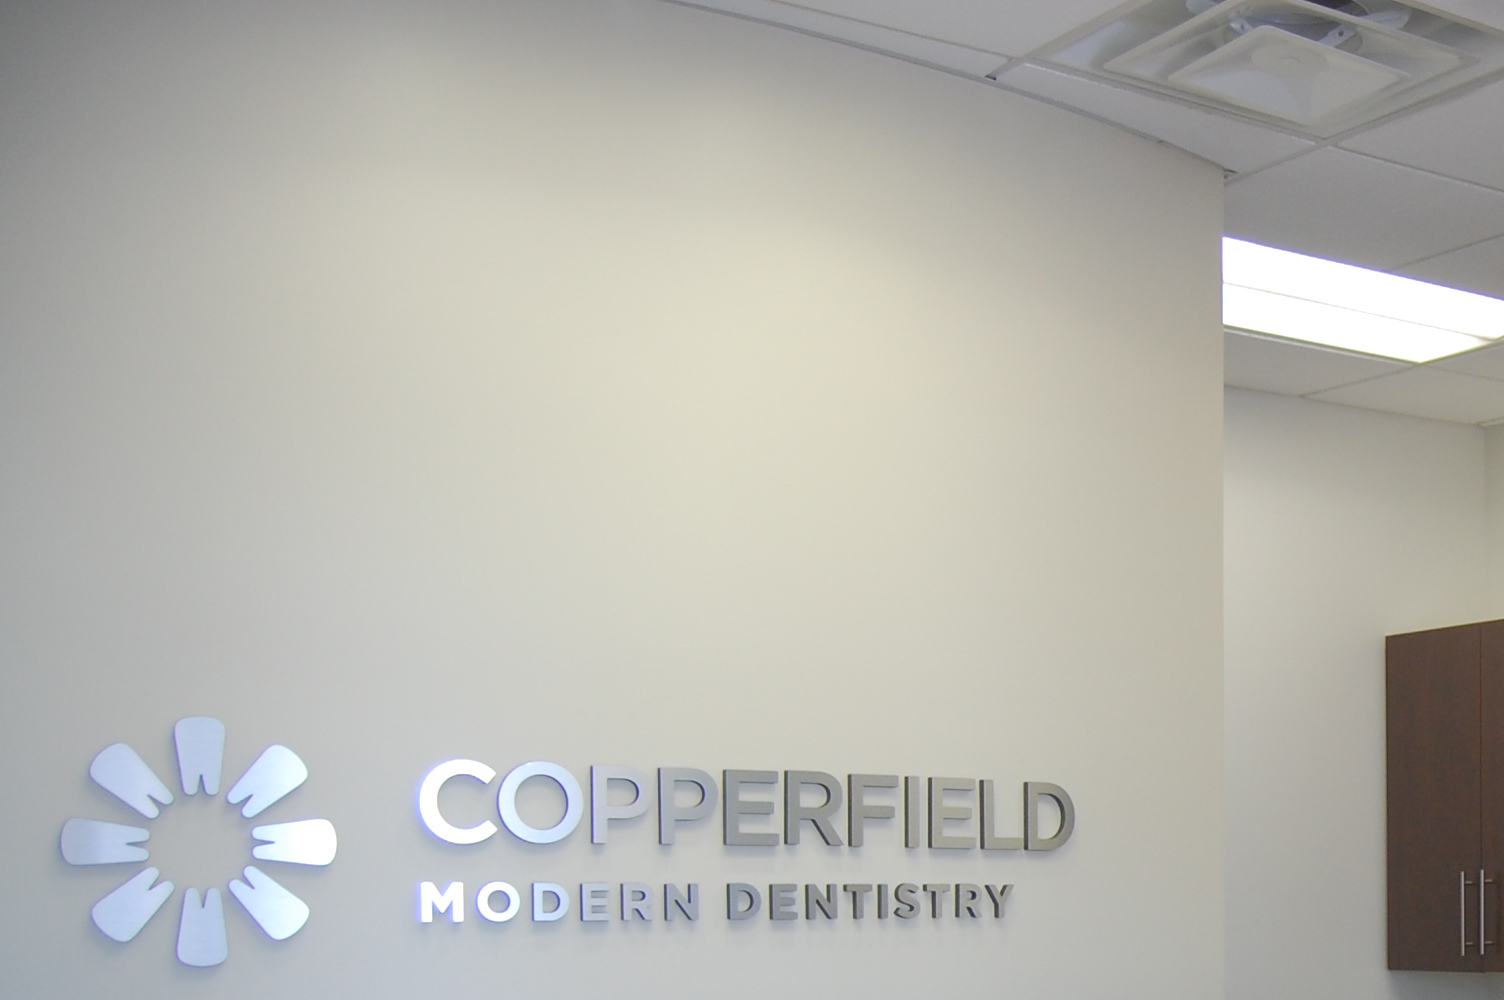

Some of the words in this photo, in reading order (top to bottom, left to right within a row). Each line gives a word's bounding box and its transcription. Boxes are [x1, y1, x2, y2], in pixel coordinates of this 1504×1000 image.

[419, 759, 1076, 852] COPPERFIELD
[420, 881, 699, 923] MODERN
[726, 881, 1013, 920] DENTISTRY
